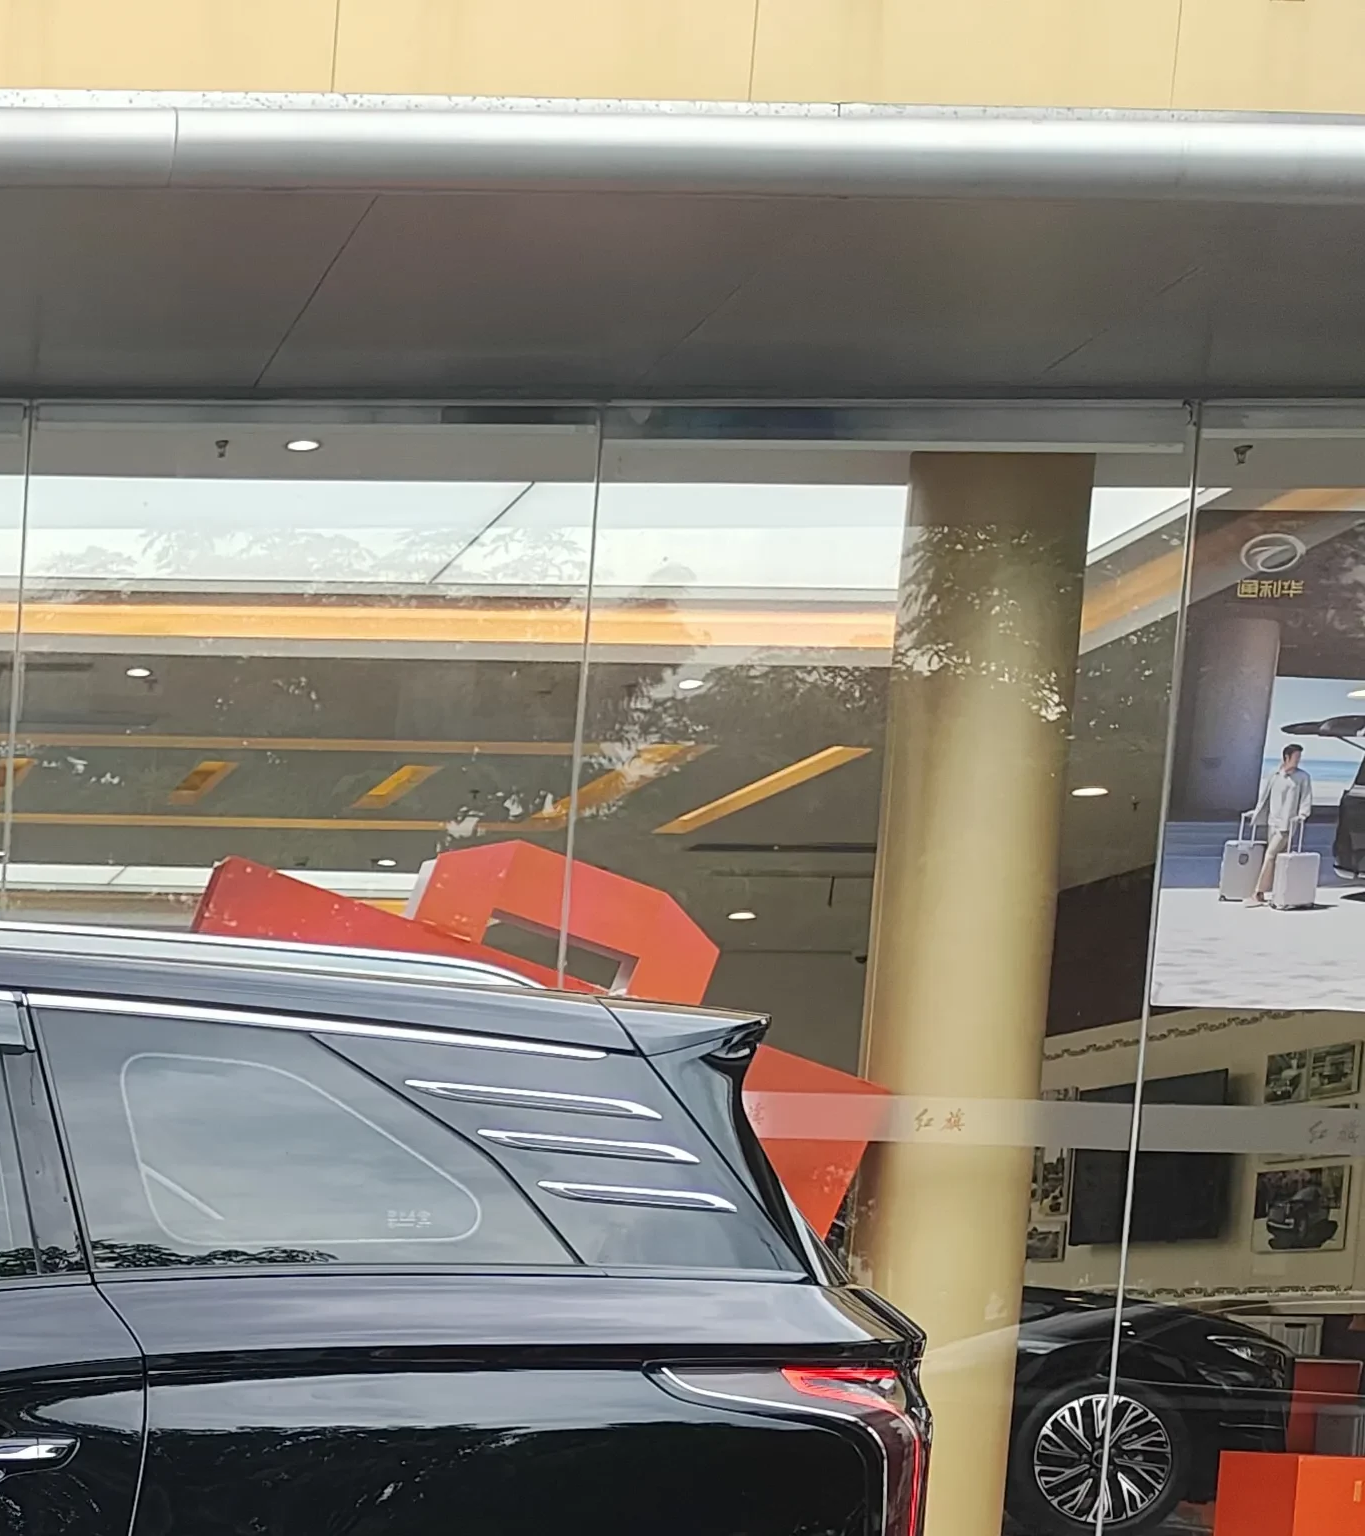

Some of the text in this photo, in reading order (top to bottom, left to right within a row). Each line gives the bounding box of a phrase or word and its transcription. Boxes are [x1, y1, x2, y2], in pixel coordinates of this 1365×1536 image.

[1237, 579, 1305, 599] 通利华
[914, 1107, 966, 1132] 红旗
